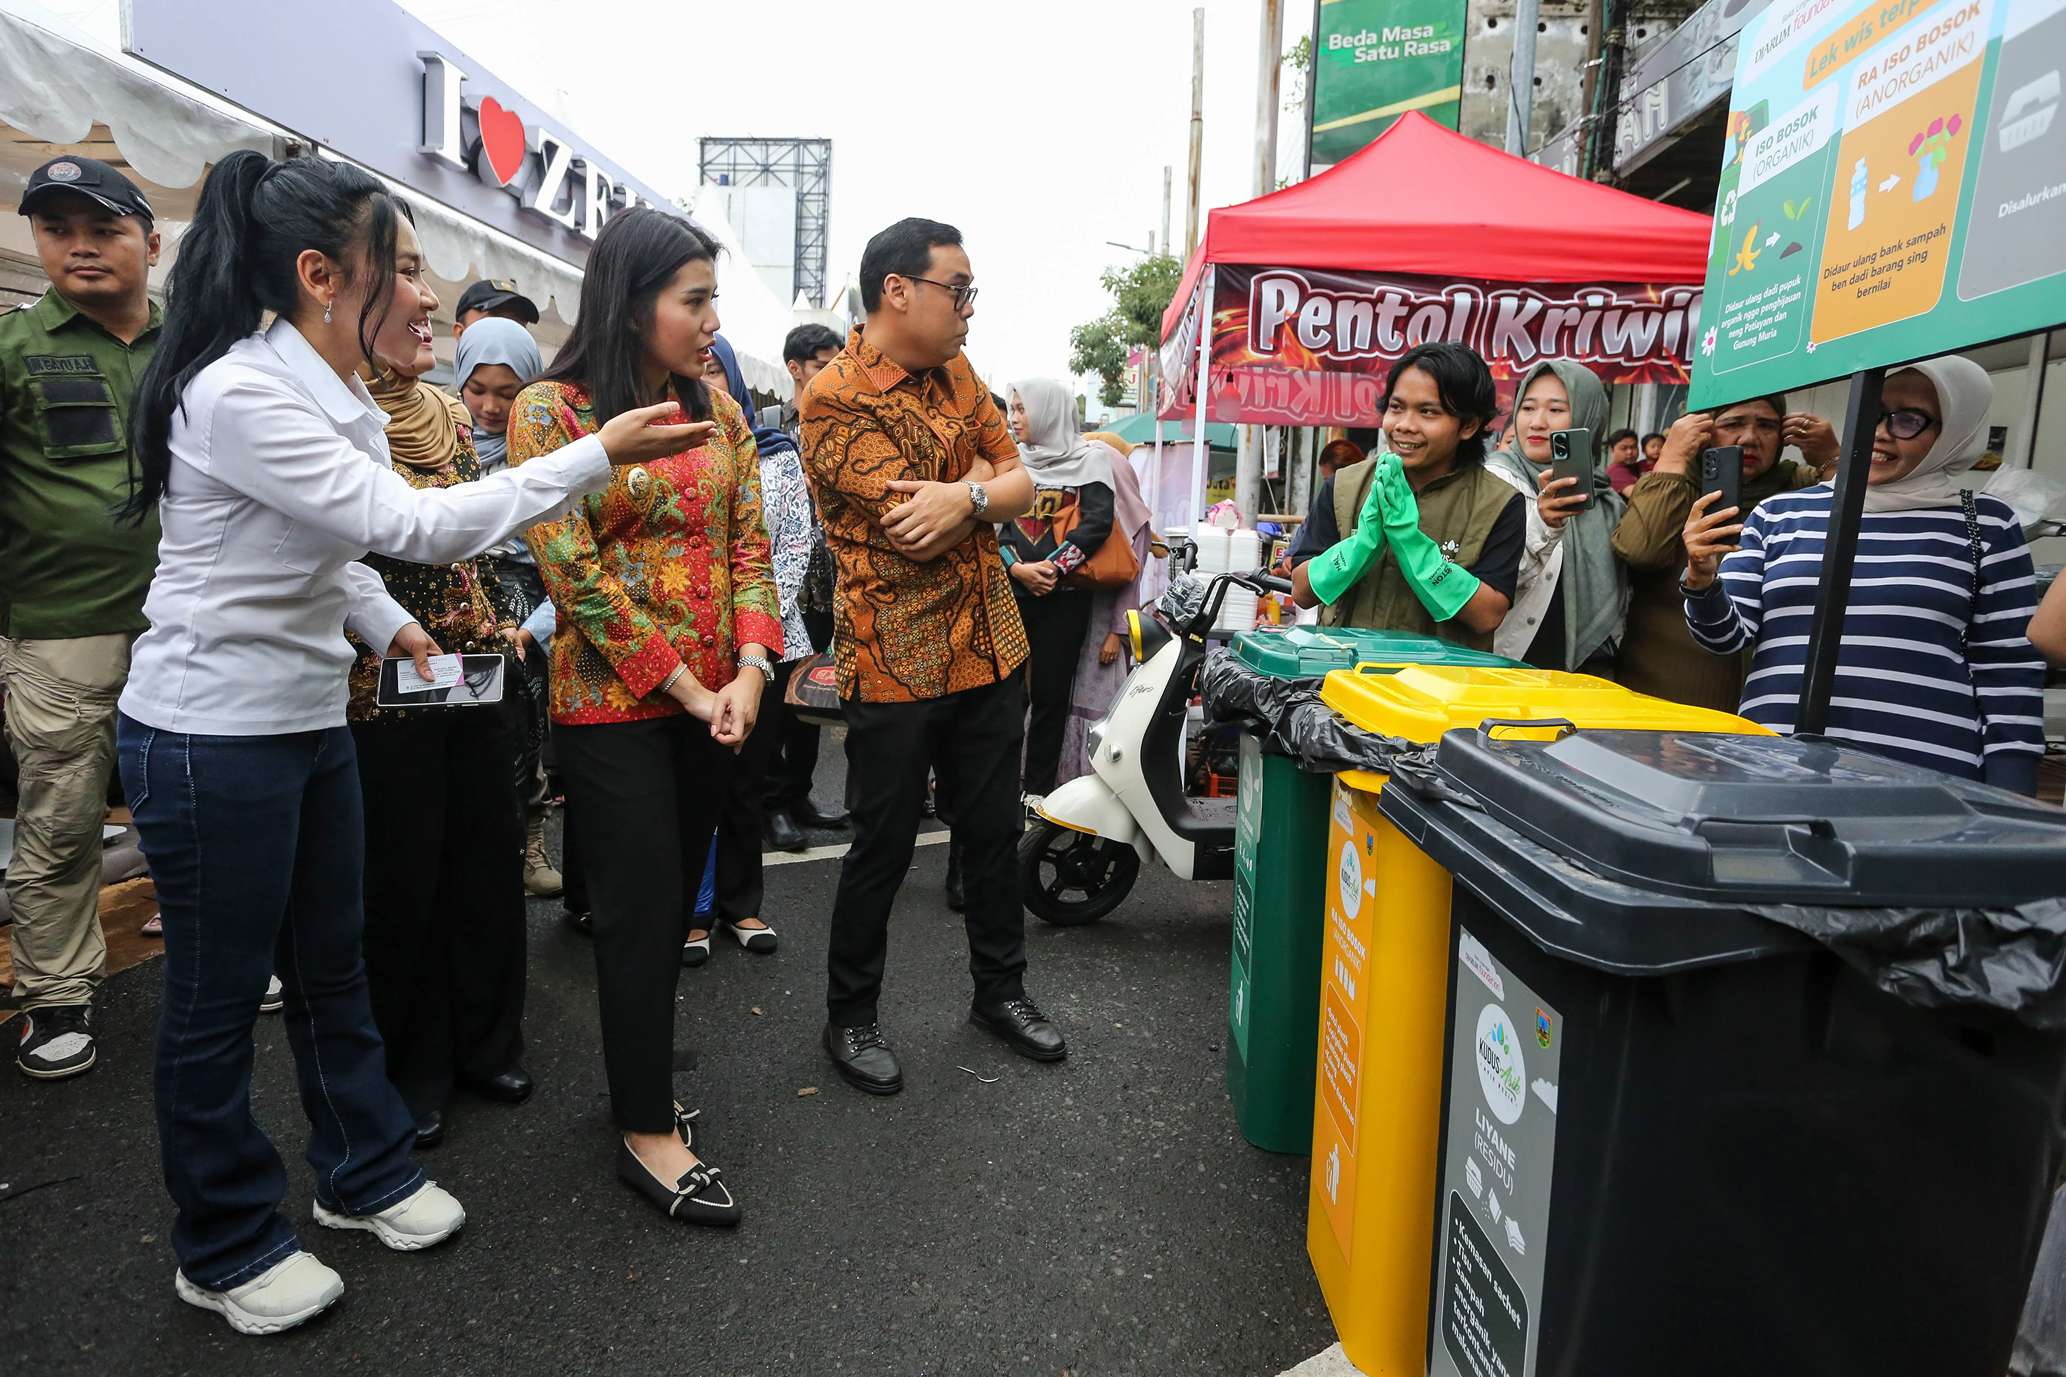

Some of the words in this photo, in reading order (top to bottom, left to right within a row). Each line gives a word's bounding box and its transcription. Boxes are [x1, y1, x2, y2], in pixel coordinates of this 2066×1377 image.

[1328, 29, 1378, 51] Beda
[1382, 25, 1434, 43] Masa
[1354, 44, 1400, 63] Satu
[1404, 40, 1451, 57] Rasa
[1809, 42, 1839, 78] Lek
[1844, 20, 1873, 53] wis
[1858, 65, 1877, 90] RA
[1883, 44, 1911, 74] ISO
[1916, 0, 1980, 53] BOSOK
[1856, 31, 1974, 120] (ANORGANIK)
[416, 50, 469, 170] I
[1755, 135, 1774, 157] ISO
[1776, 105, 1818, 144] BOSOK
[1753, 129, 1815, 181] (ORGANIK)
[1998, 183, 2066, 218] Disalurkan
[1824, 261, 1851, 279] Didaur
[1853, 251, 1877, 268] ulang
[1880, 239, 1903, 257] bank
[1905, 222, 1946, 248] sampah
[1832, 279, 1847, 292] ben
[1849, 269, 1869, 285] dadi
[1871, 258, 1904, 277] barang
[1907, 250, 1928, 265] sing
[1255, 275, 1475, 355] Pentol
[1856, 277, 1892, 298] bernilai
[1479, 1037, 1501, 1075] KUDUS
[1500, 1065, 1522, 1097] Asik
[1474, 1131, 1513, 1197] (RESIDU)
[1475, 1107, 1516, 1172] LIYANE
[1458, 1239, 1472, 1273] Tisu
[1458, 1221, 1492, 1283] Kemasan
[1493, 1279, 1521, 1330] sachet
[1456, 1261, 1485, 1317] Sampah
[1454, 1283, 1491, 1351] anorganik
[1491, 1347, 1511, 1377] yan
